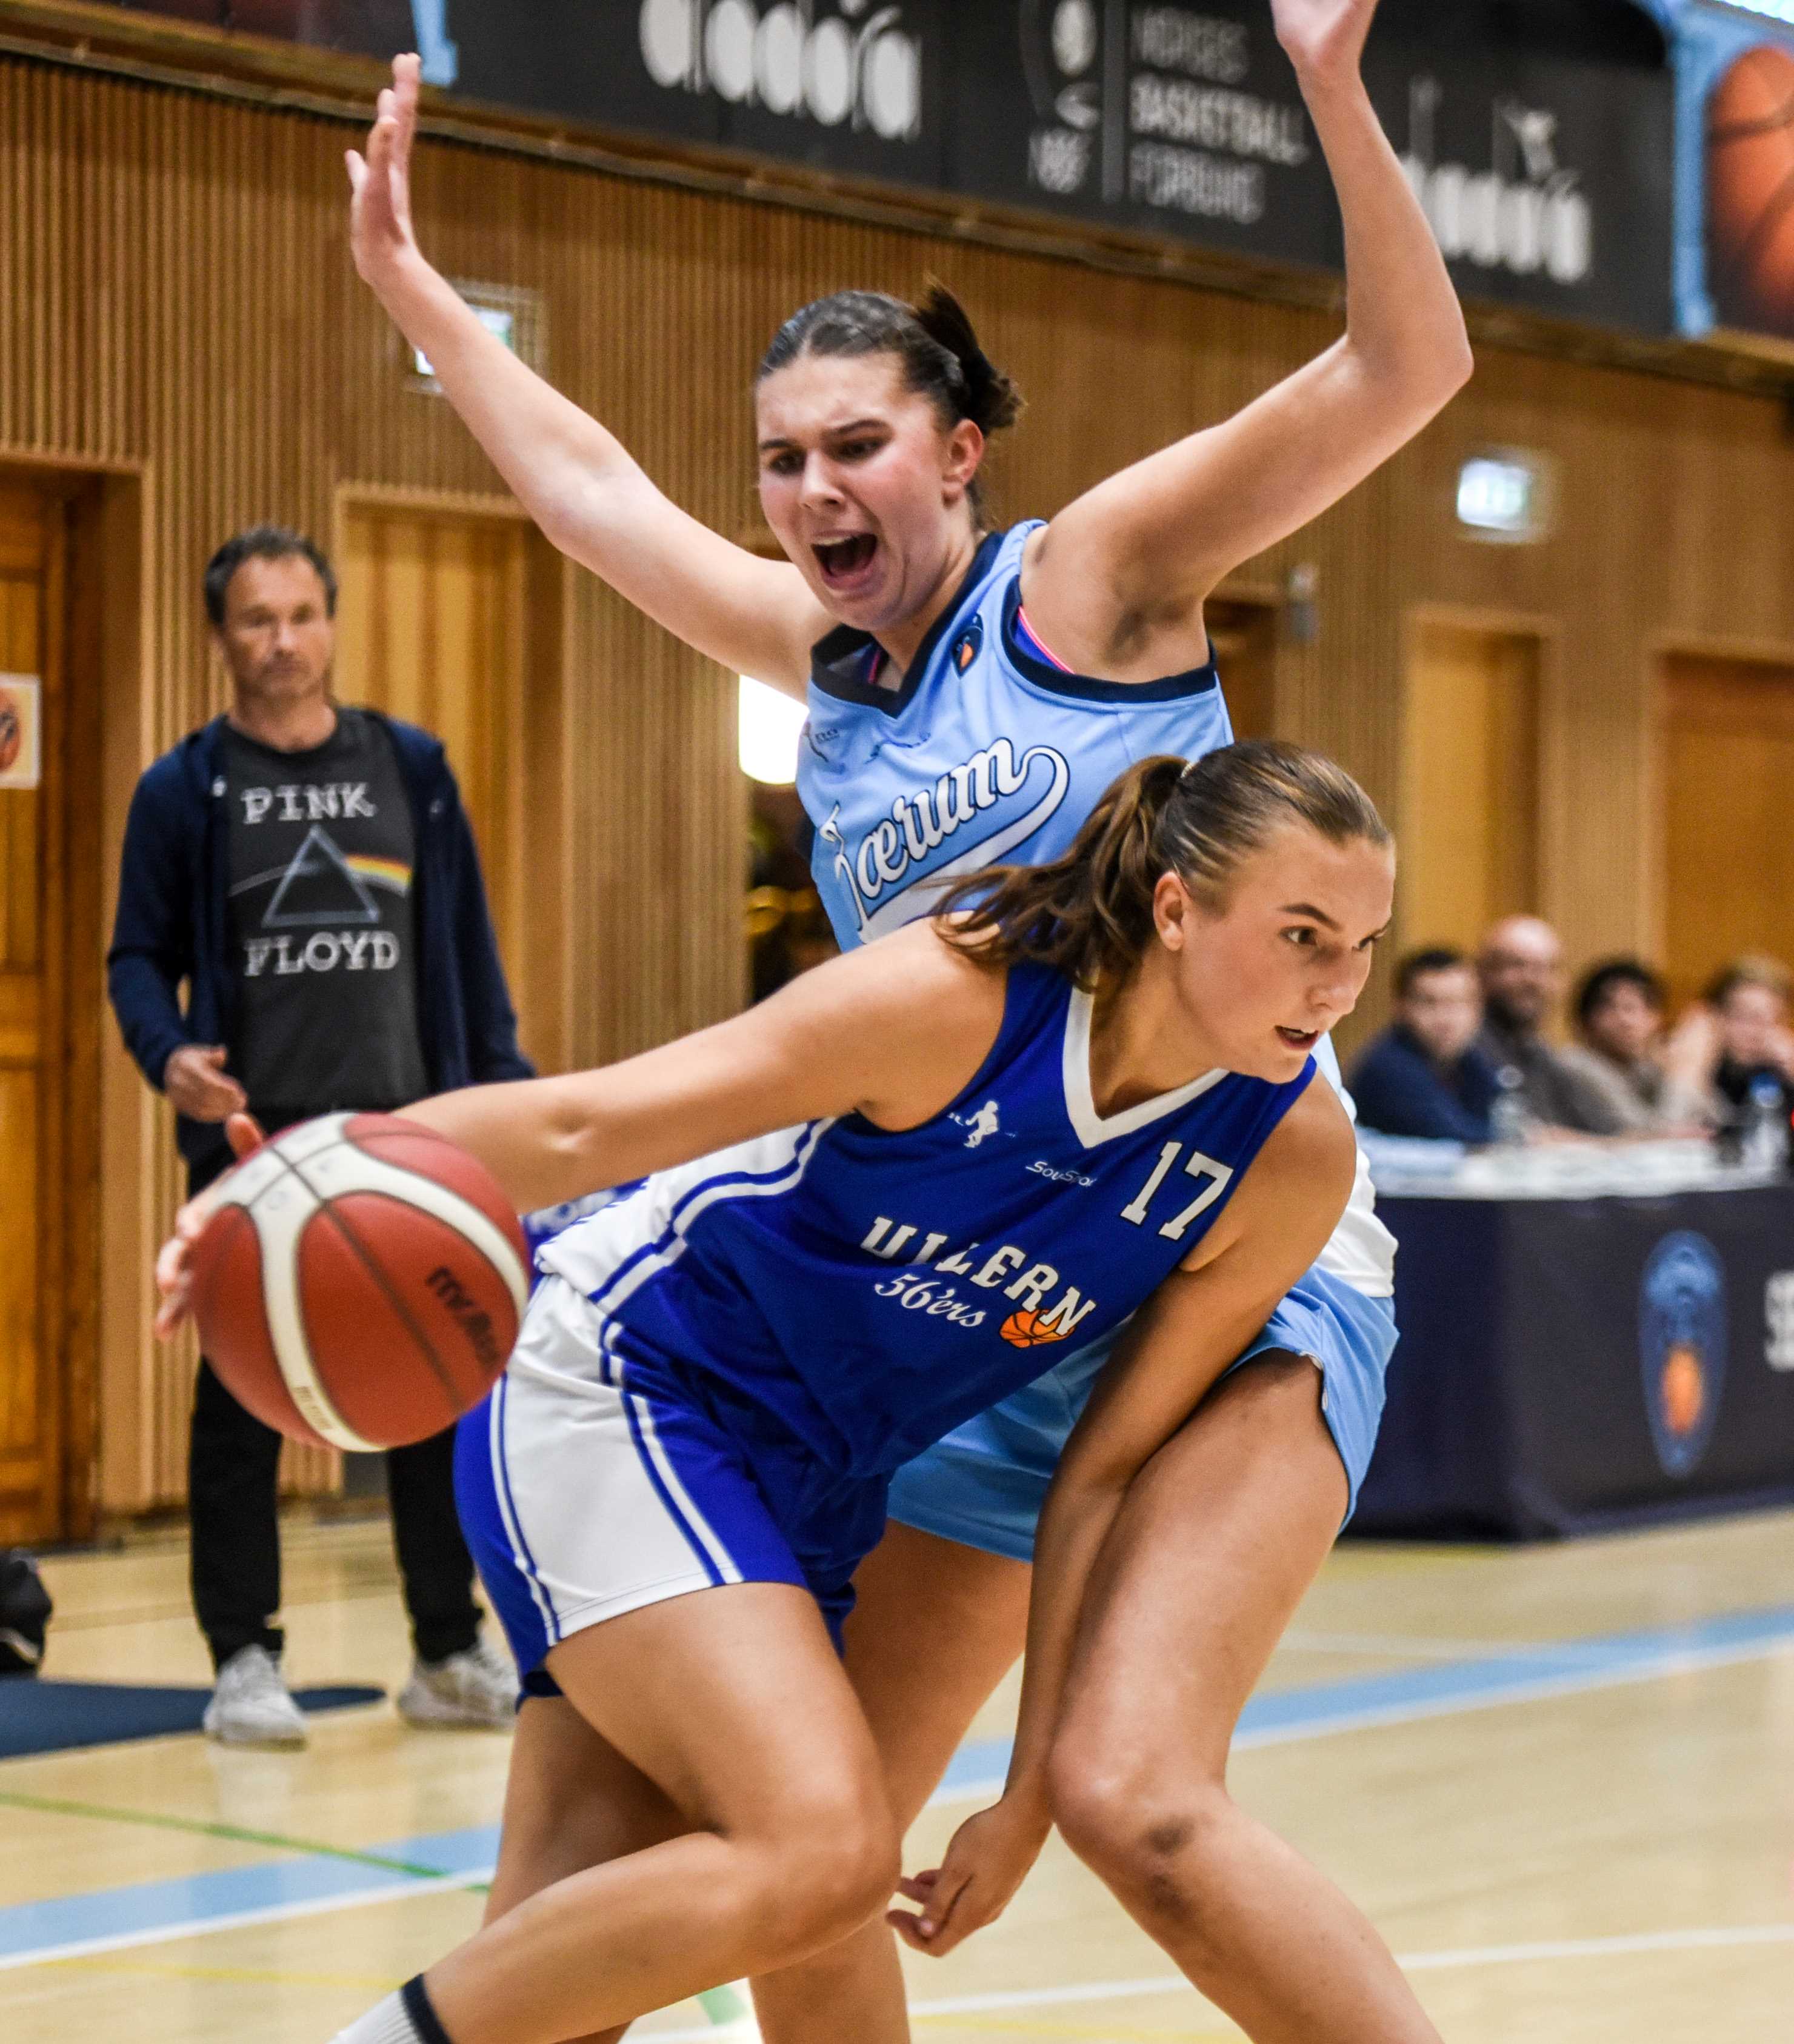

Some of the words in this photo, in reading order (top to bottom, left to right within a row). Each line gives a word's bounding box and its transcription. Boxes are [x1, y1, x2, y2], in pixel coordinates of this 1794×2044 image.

[240, 782, 377, 825] PINK
[243, 930, 400, 977] FLOYD
[1121, 1141, 1234, 1240] 17
